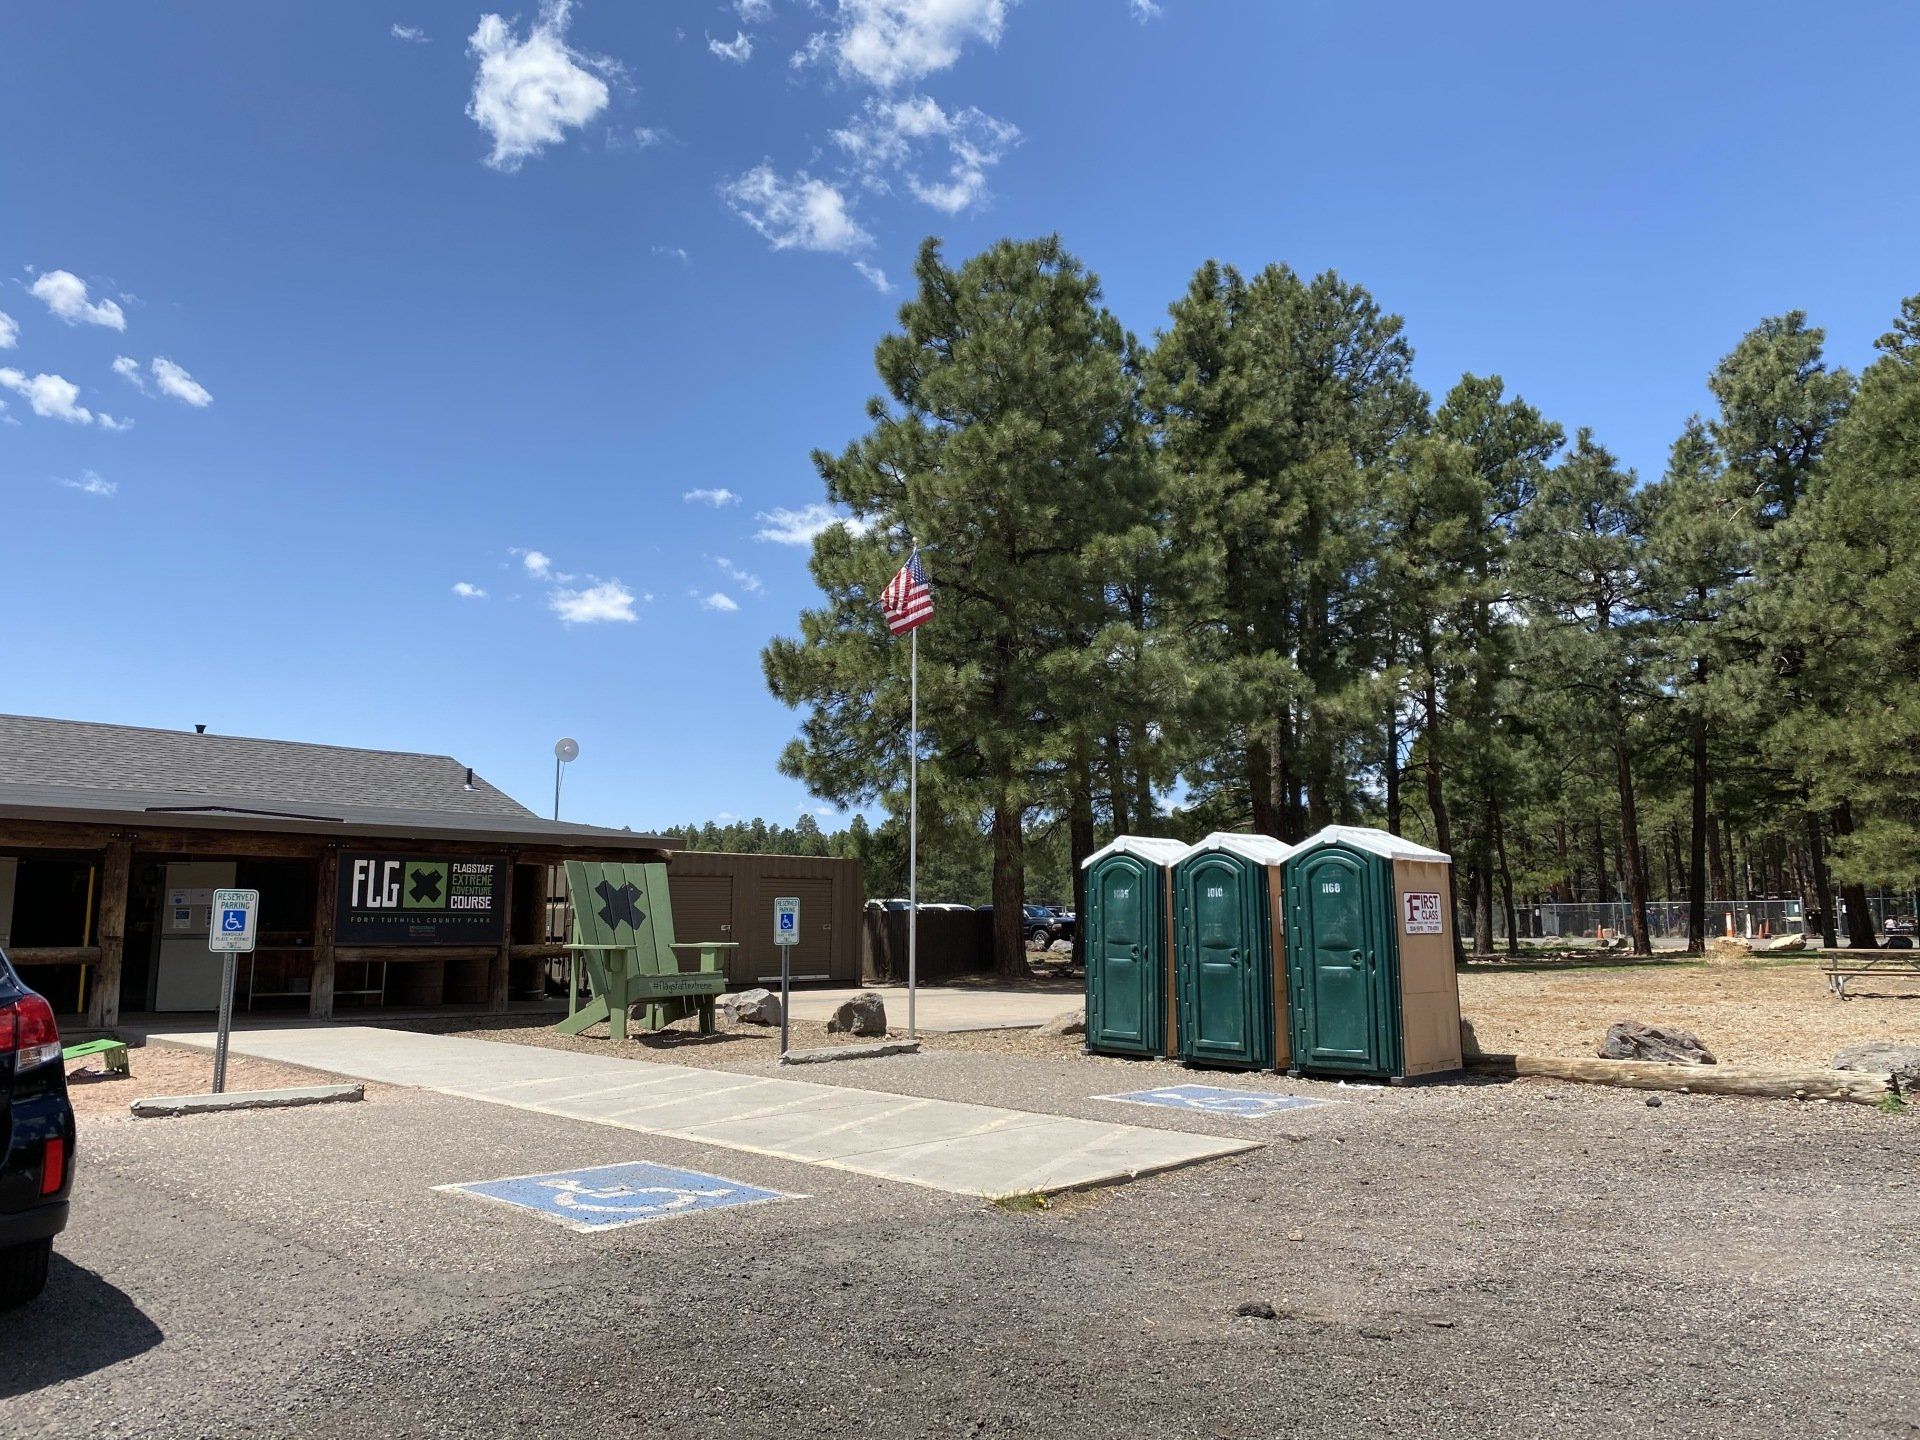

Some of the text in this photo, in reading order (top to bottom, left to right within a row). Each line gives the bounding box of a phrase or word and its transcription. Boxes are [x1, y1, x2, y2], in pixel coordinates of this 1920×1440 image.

[452, 863, 494, 874] FLAGSTAFF
[352, 859, 400, 908] FLG
[452, 874, 493, 886] EXTREME
[451, 886, 492, 896] ADVENTURE
[1207, 887, 1223, 898] 1010
[1322, 883, 1341, 894] 1168
[217, 892, 255, 901] RESERVED
[450, 895, 492, 909] COURSE
[1421, 910, 1439, 920] CLASS
